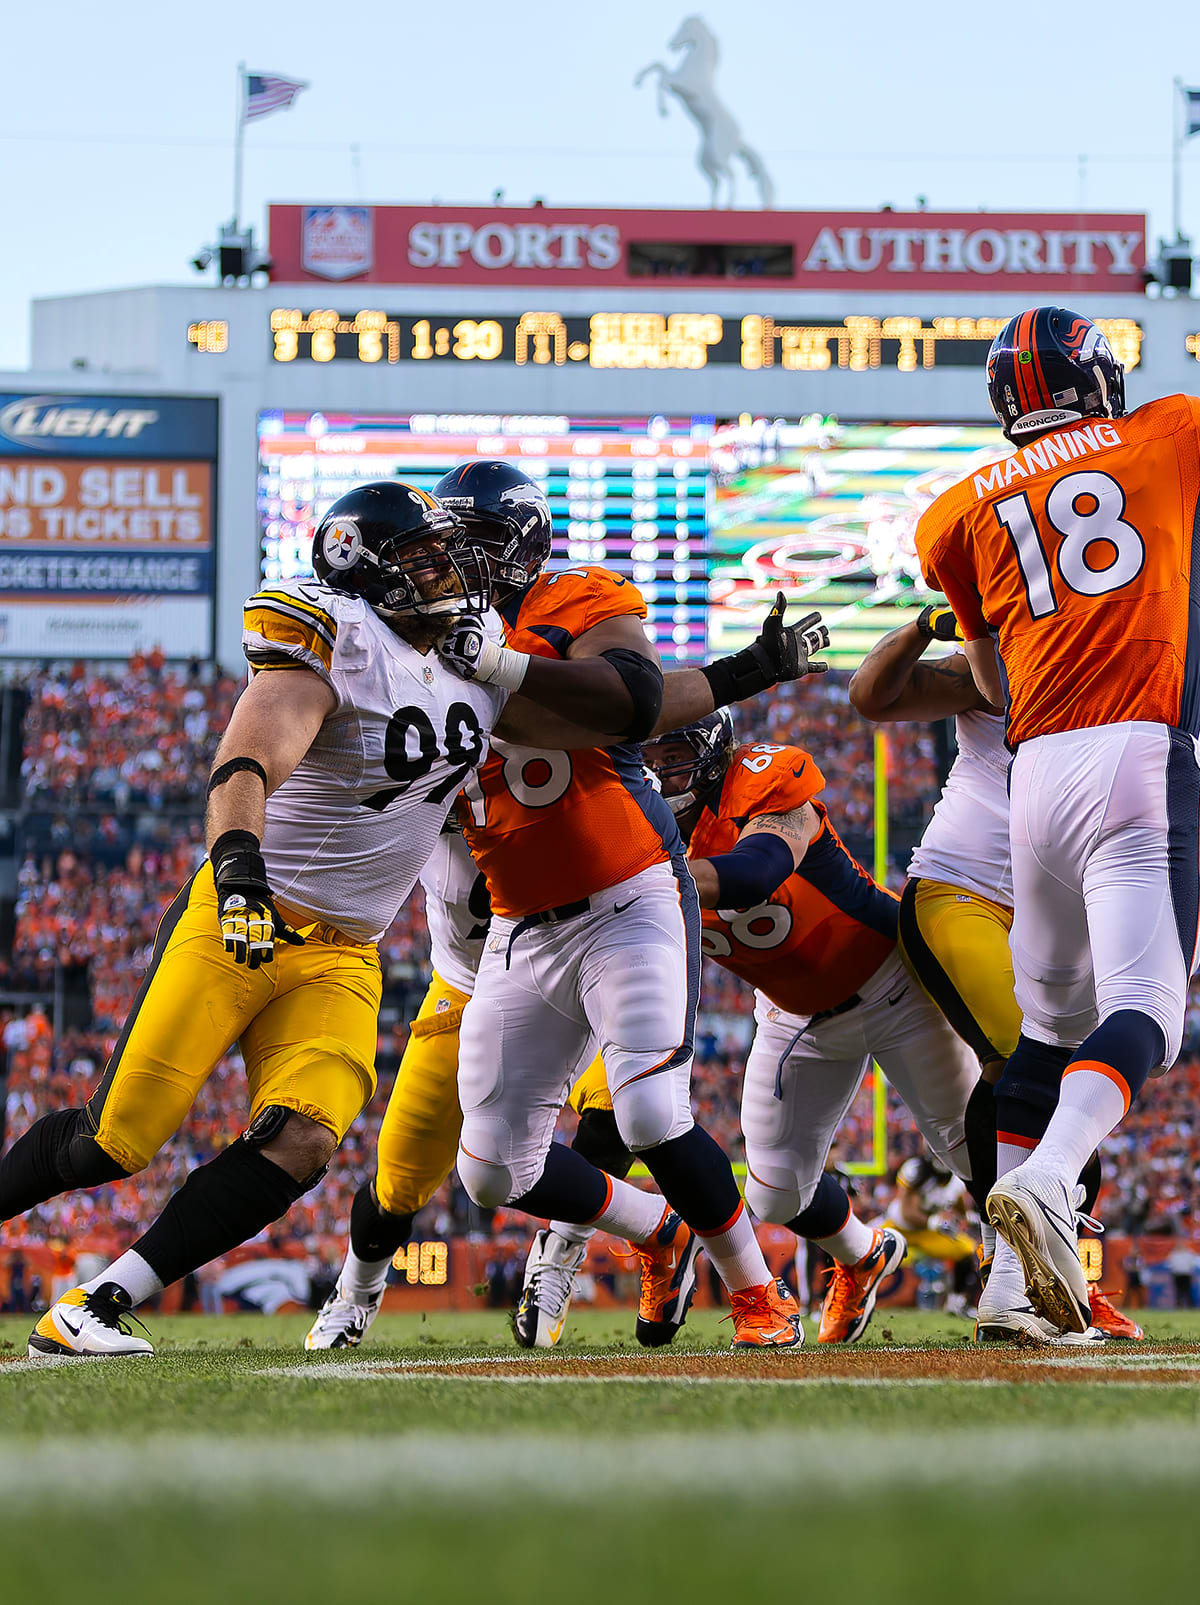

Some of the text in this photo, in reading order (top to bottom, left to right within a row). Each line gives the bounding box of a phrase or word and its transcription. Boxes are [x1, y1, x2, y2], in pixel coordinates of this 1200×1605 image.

[408, 222, 621, 269] SPORTS
[804, 227, 1142, 275] AUTHORITY
[411, 319, 503, 360] 1:30
[14, 407, 159, 438] LIGHT
[1007, 404, 1019, 416] 18
[1016, 411, 1068, 430] BRONCOS
[973, 422, 1122, 500] MANNING
[79, 466, 202, 508] SELL
[40, 510, 203, 541] TICKETS
[993, 469, 1146, 622] 18
[392, 1241, 448, 1285] 40
